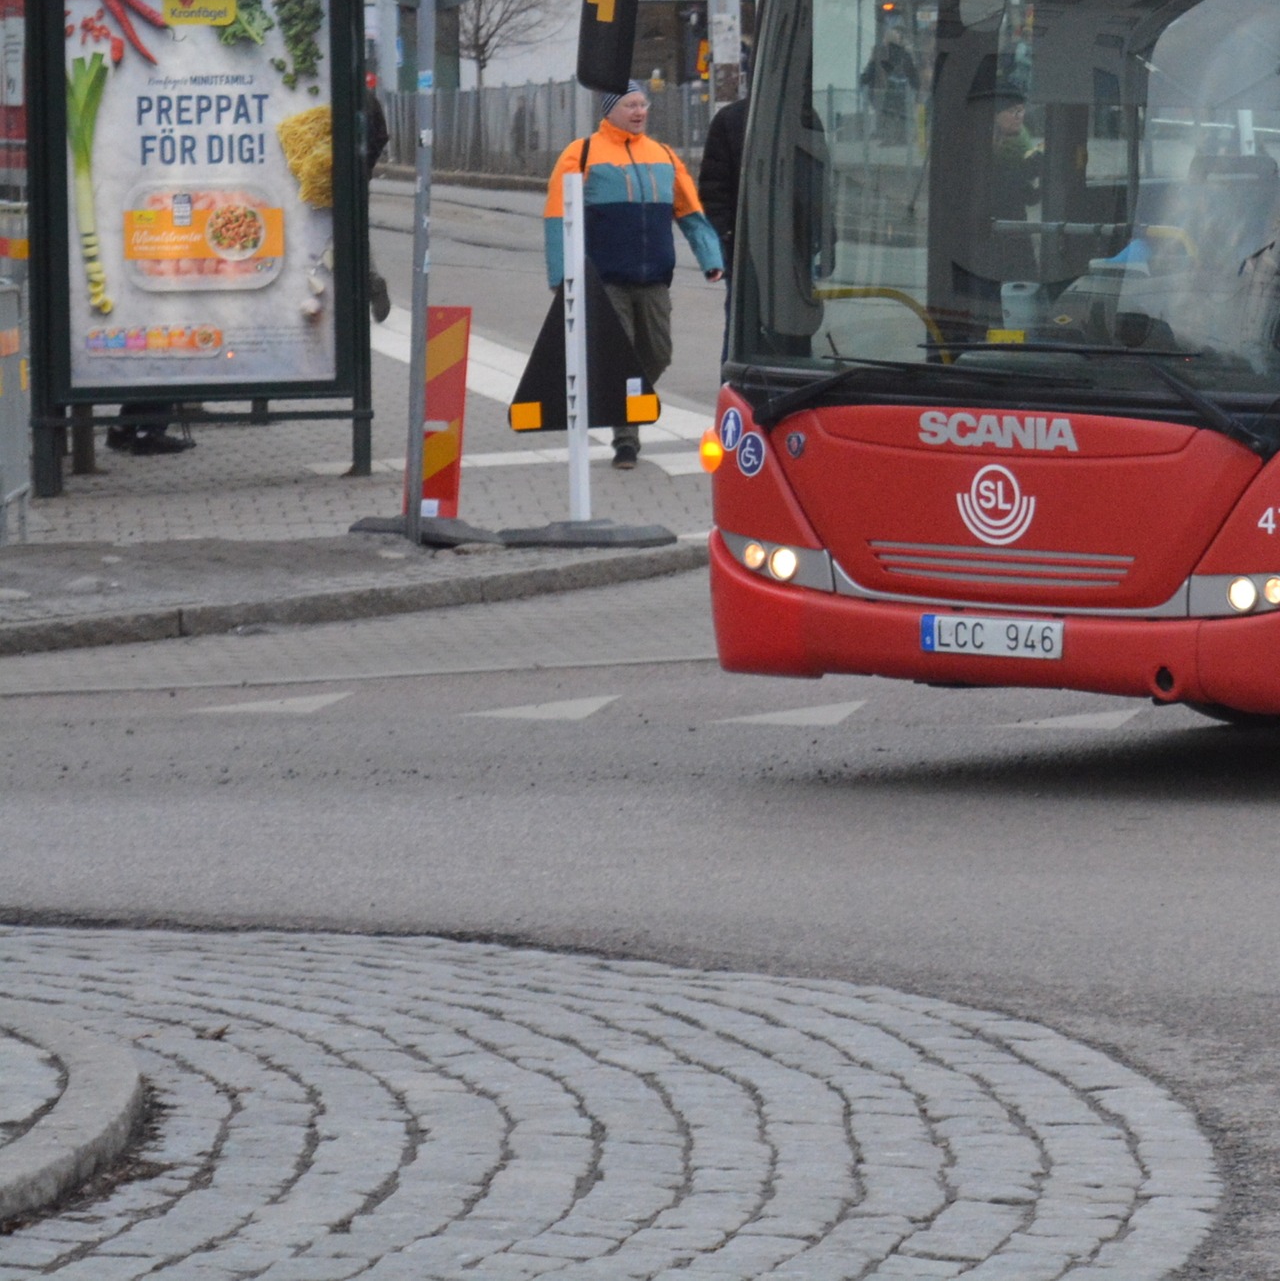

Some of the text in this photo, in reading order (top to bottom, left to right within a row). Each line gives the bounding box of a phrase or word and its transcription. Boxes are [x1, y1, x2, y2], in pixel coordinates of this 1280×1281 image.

[170, 7, 228, 21] Kronfågel
[136, 93, 270, 126] PREPPAT
[140, 127, 265, 166] FÖR DIG!
[917, 410, 1079, 453] SCANIA
[978, 480, 1012, 511] SL
[937, 619, 985, 650] LCC
[1005, 623, 1055, 654] 946
